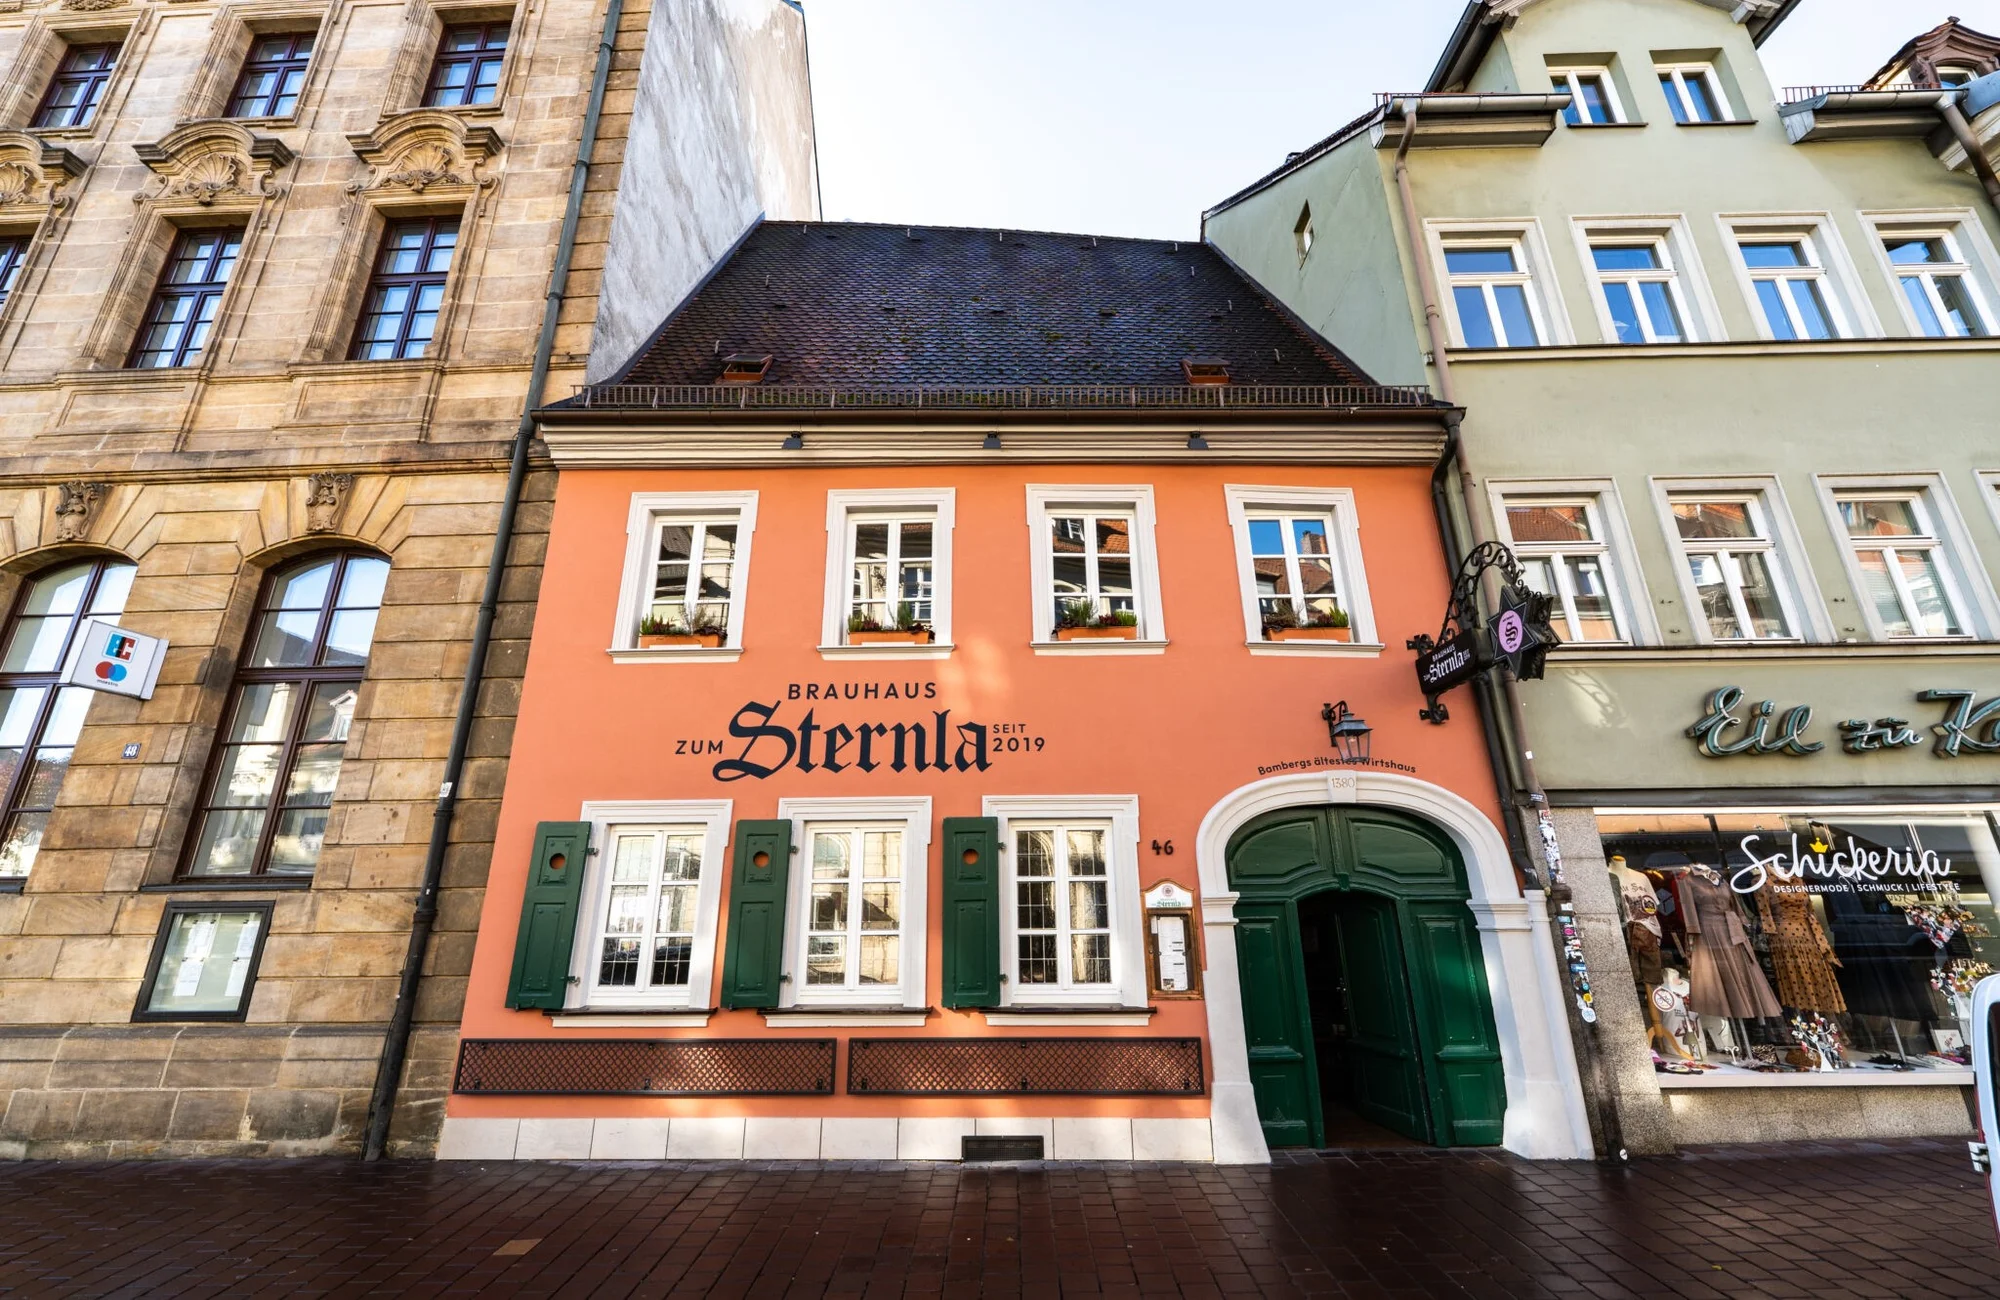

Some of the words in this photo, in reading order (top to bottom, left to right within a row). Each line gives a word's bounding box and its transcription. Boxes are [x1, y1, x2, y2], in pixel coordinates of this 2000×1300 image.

[1429, 650, 1465, 684] Sternla
[787, 682, 937, 700] BRAUHAUS
[993, 723, 1027, 734] SEIT
[1685, 685, 1826, 758] Eil
[1838, 717, 1924, 755] zu
[1916, 688, 2000, 759] K
[675, 739, 724, 755] ZUM
[712, 700, 993, 782] Sternla
[993, 736, 1046, 753] 2019
[124, 744, 138, 757] 48
[1257, 759, 1312, 775] Bambergs
[1331, 777, 1356, 789] 1380
[1151, 839, 1174, 856] 46
[1730, 833, 1951, 894] Schickeria
[1773, 884, 1849, 893] DESIGNERMODE
[1857, 884, 1904, 892] SCHMUCK
[1911, 882, 1961, 892] LIFESTYLE
